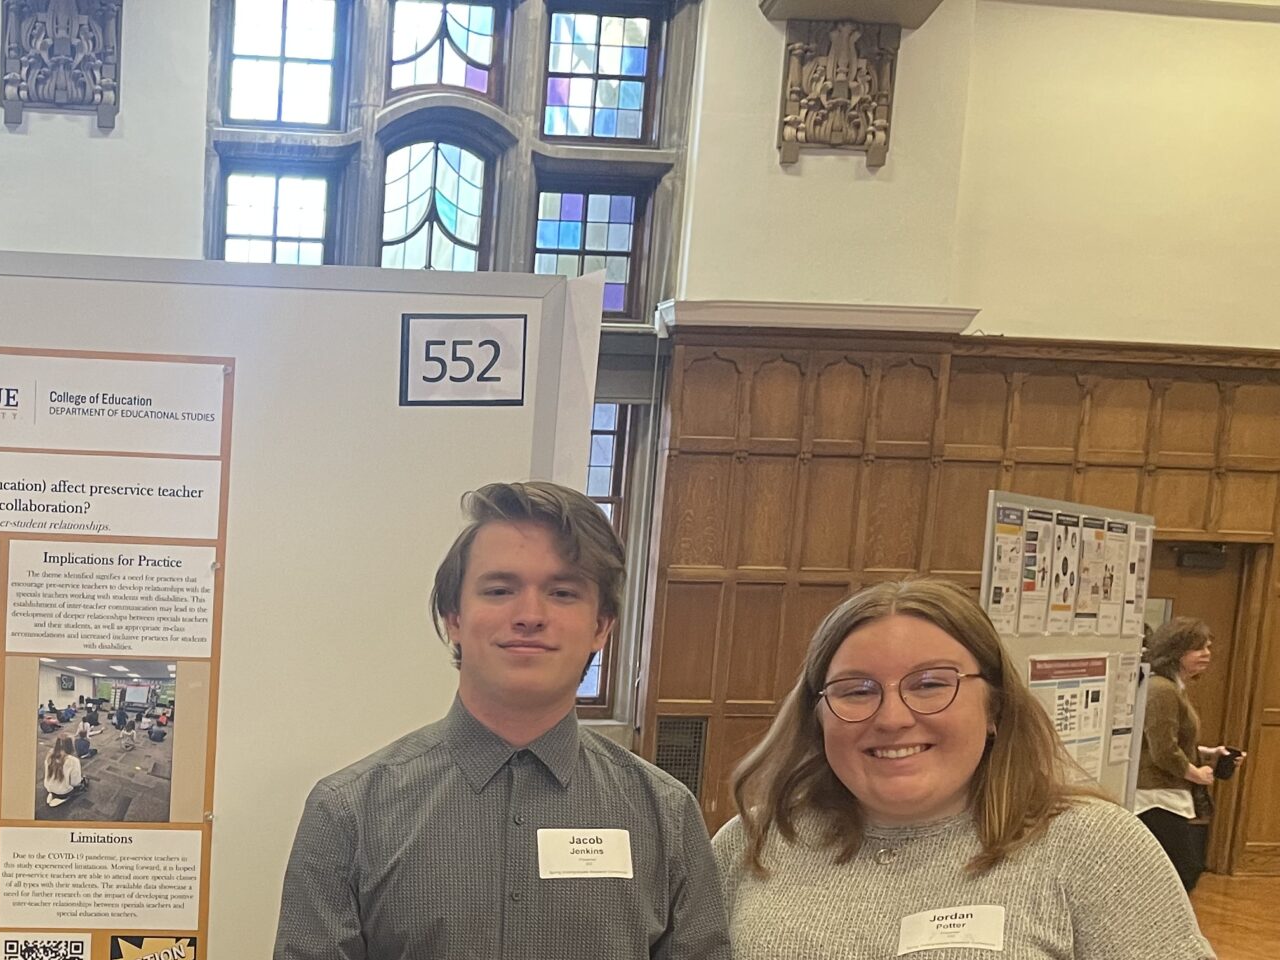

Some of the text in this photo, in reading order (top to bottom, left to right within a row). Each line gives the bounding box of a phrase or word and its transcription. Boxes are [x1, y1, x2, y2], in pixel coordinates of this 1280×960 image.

[422, 339, 502, 383] 552
[49, 390, 152, 406] College of Education
[48, 406, 215, 421] DEPARTMENT OF EDUCATIONAL STUDIES
[50, 479, 86, 493] affect
[88, 483, 154, 496] preservice
[157, 484, 204, 498] teacher
[48, 519, 110, 531] relationships.
[42, 551, 182, 567] Implications for Practice
[69, 831, 133, 843] Limitations
[569, 836, 603, 845] Jacob
[929, 912, 974, 922] Jordan
[935, 922, 966, 930] Potter
